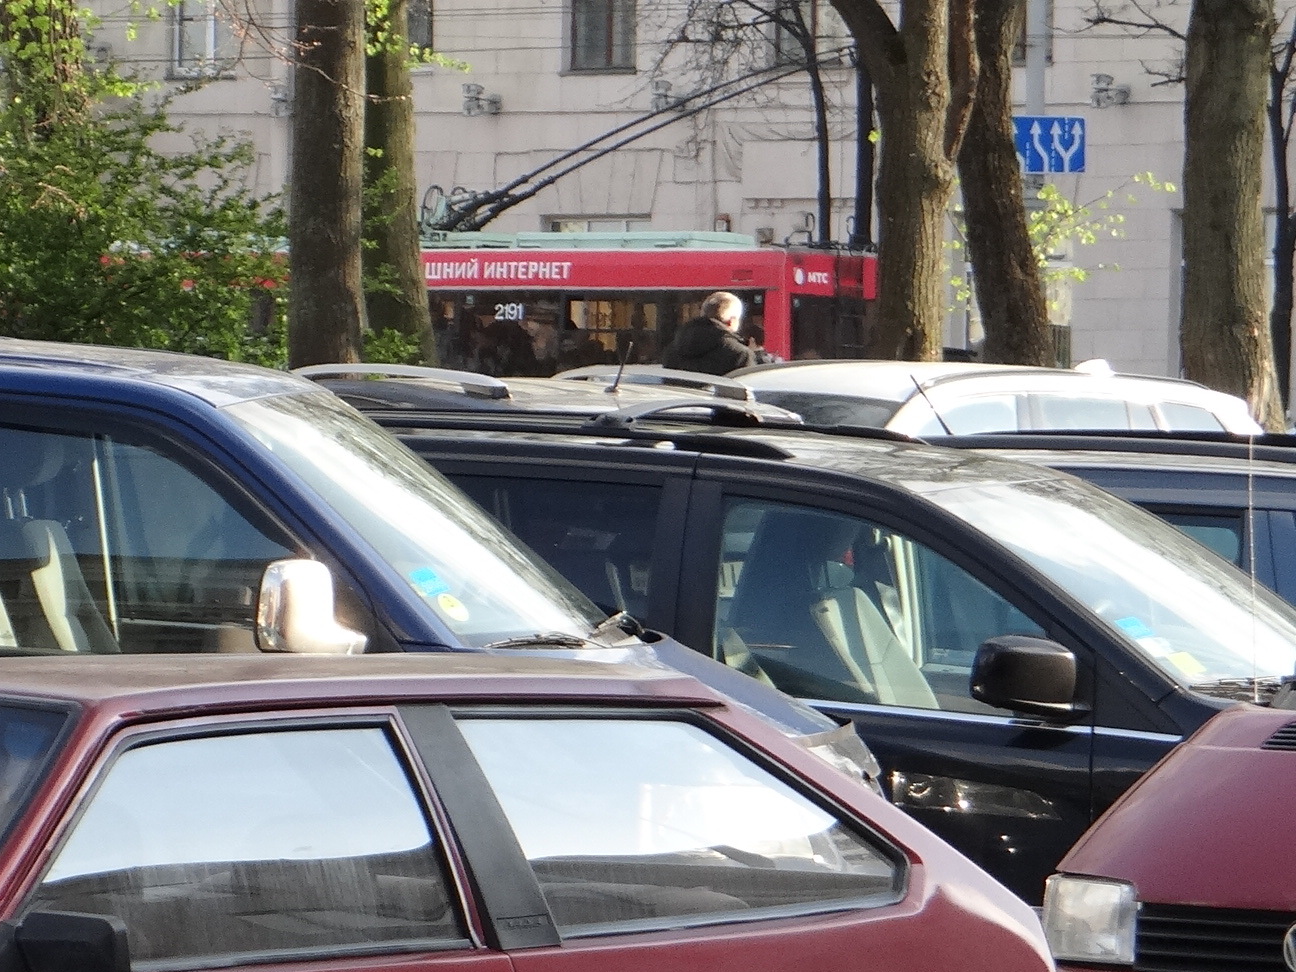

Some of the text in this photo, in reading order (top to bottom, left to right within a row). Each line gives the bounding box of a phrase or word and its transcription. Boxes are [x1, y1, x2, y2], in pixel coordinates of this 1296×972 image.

[483, 261, 572, 280] ИНТЕРНЕТ
[807, 271, 829, 284] МТС
[494, 302, 524, 320] 2191
